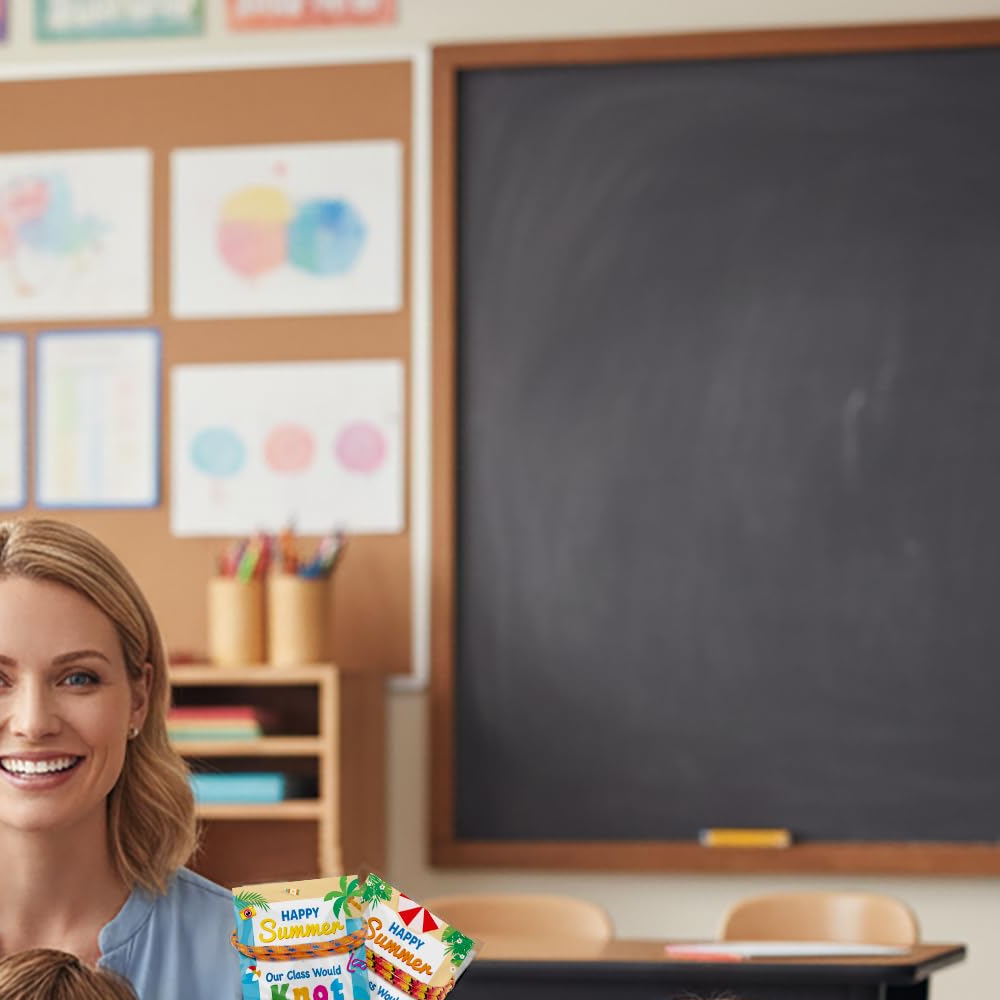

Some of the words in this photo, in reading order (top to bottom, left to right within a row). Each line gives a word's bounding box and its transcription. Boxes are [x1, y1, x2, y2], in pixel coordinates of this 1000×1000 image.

[281, 907, 319, 922] HAPPY
[258, 917, 345, 943] Summer
[388, 921, 425, 950] HAPPY
[367, 917, 433, 976] Summer
[265, 971, 286, 983] Our
[286, 968, 311, 982] Class
[313, 965, 342, 979] Would
